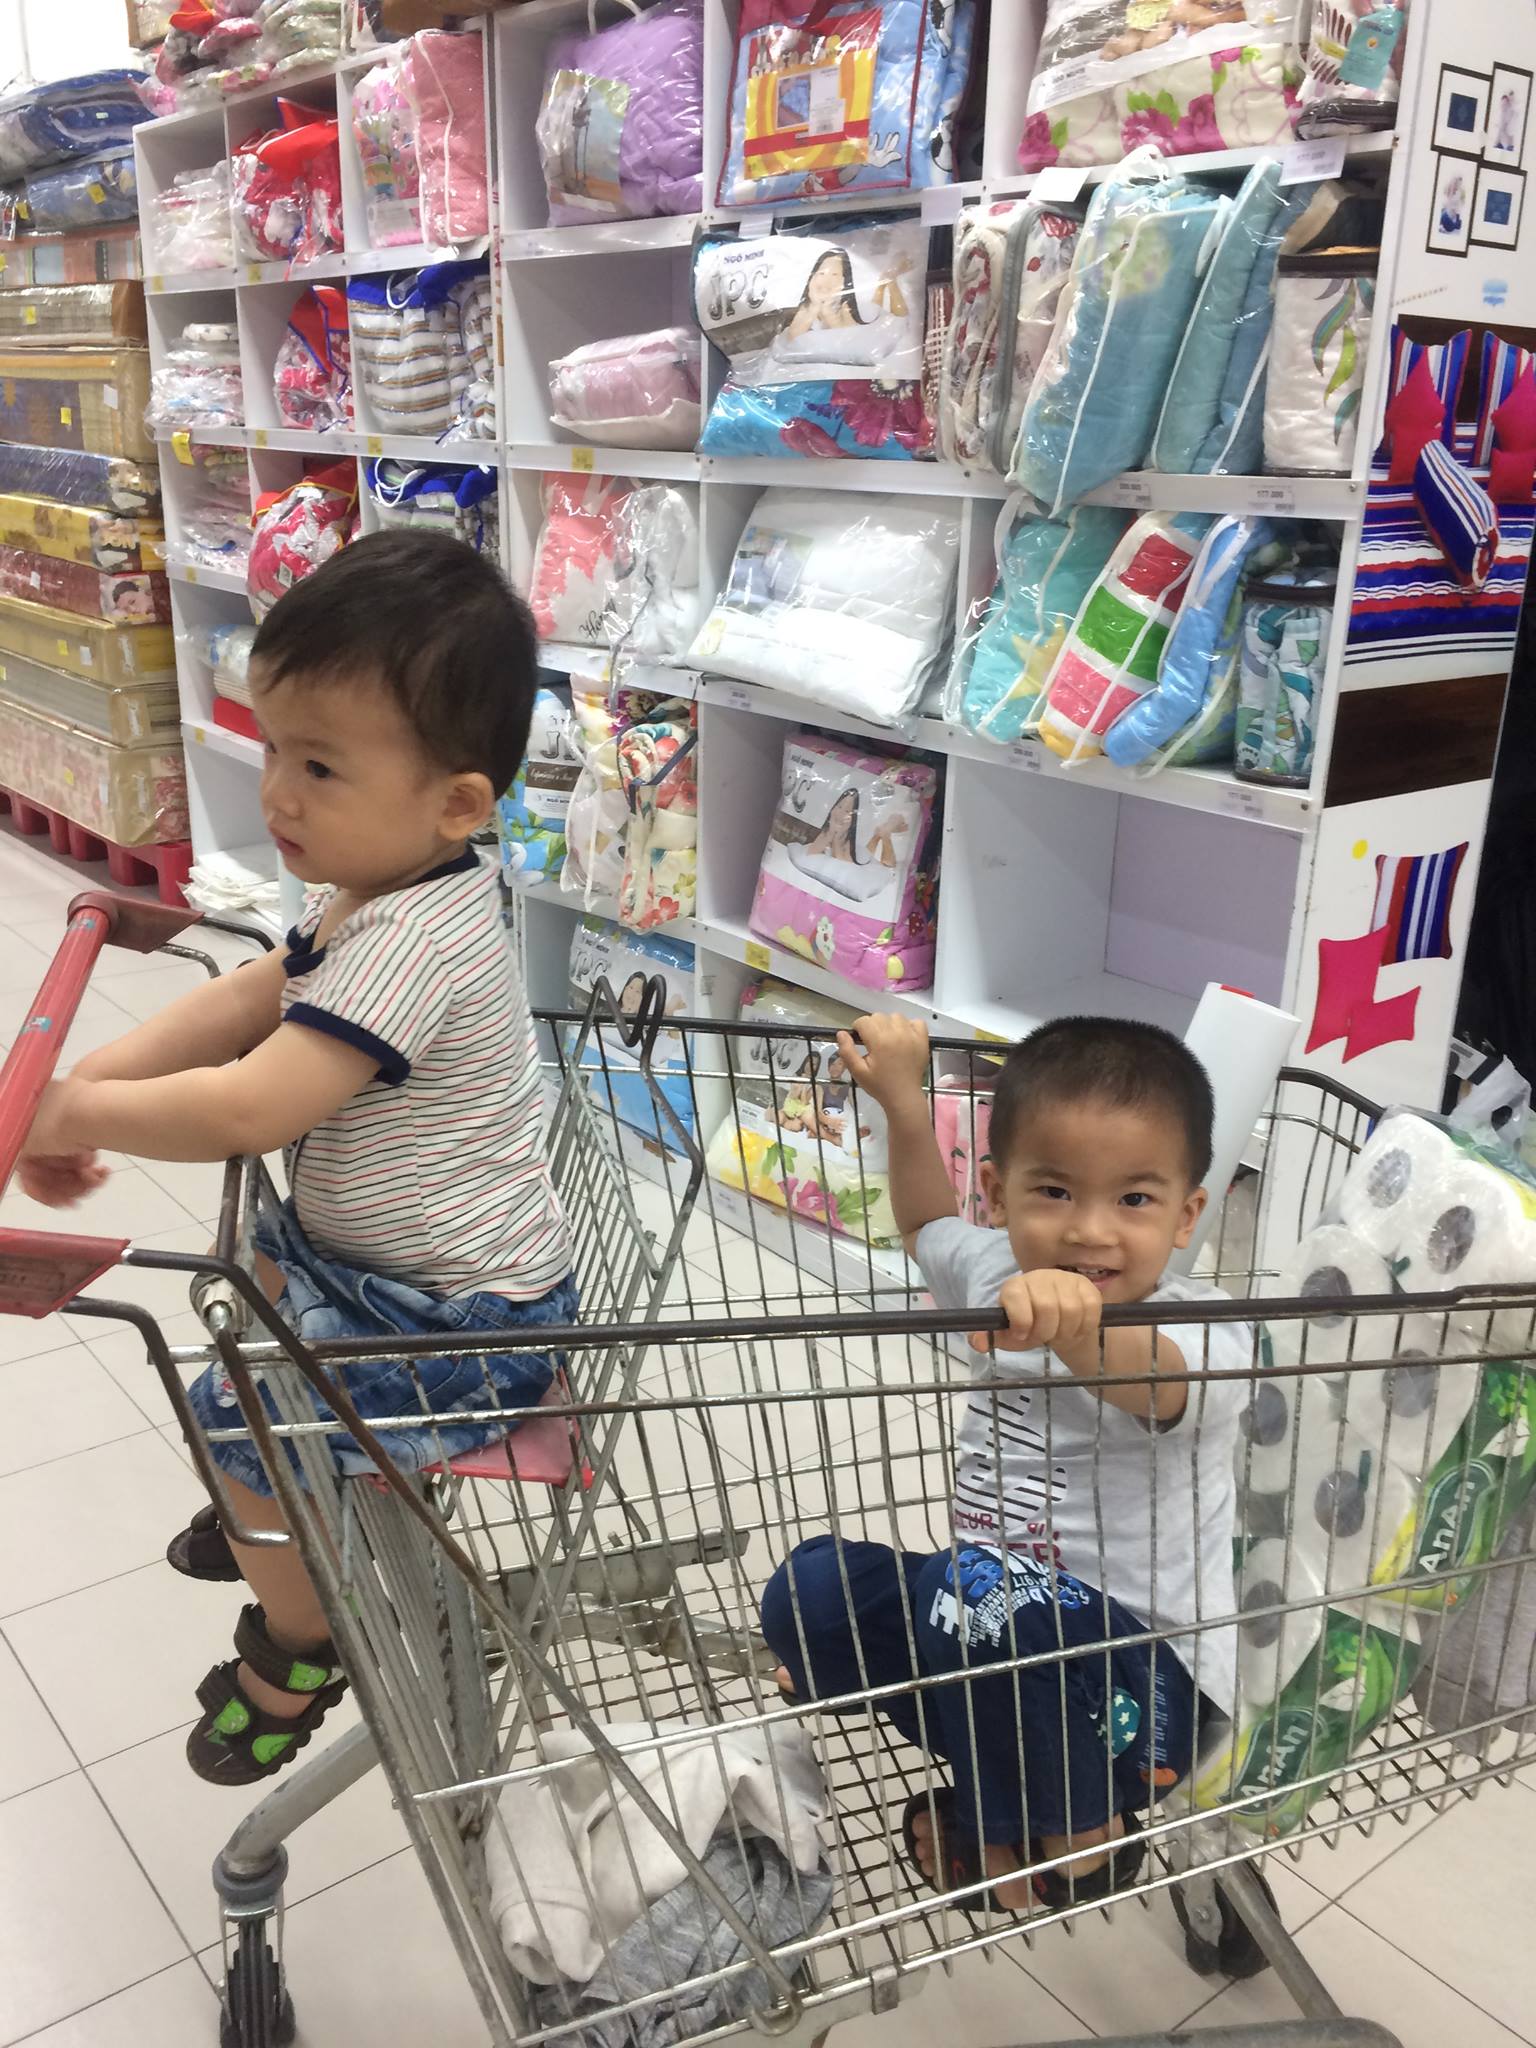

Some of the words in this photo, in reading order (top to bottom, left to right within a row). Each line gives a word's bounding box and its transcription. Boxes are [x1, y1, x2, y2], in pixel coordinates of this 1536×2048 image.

[708, 264, 769, 321] JPC
[1419, 1481, 1476, 1574] AnAn
[1240, 1725, 1310, 1809] AnAn
